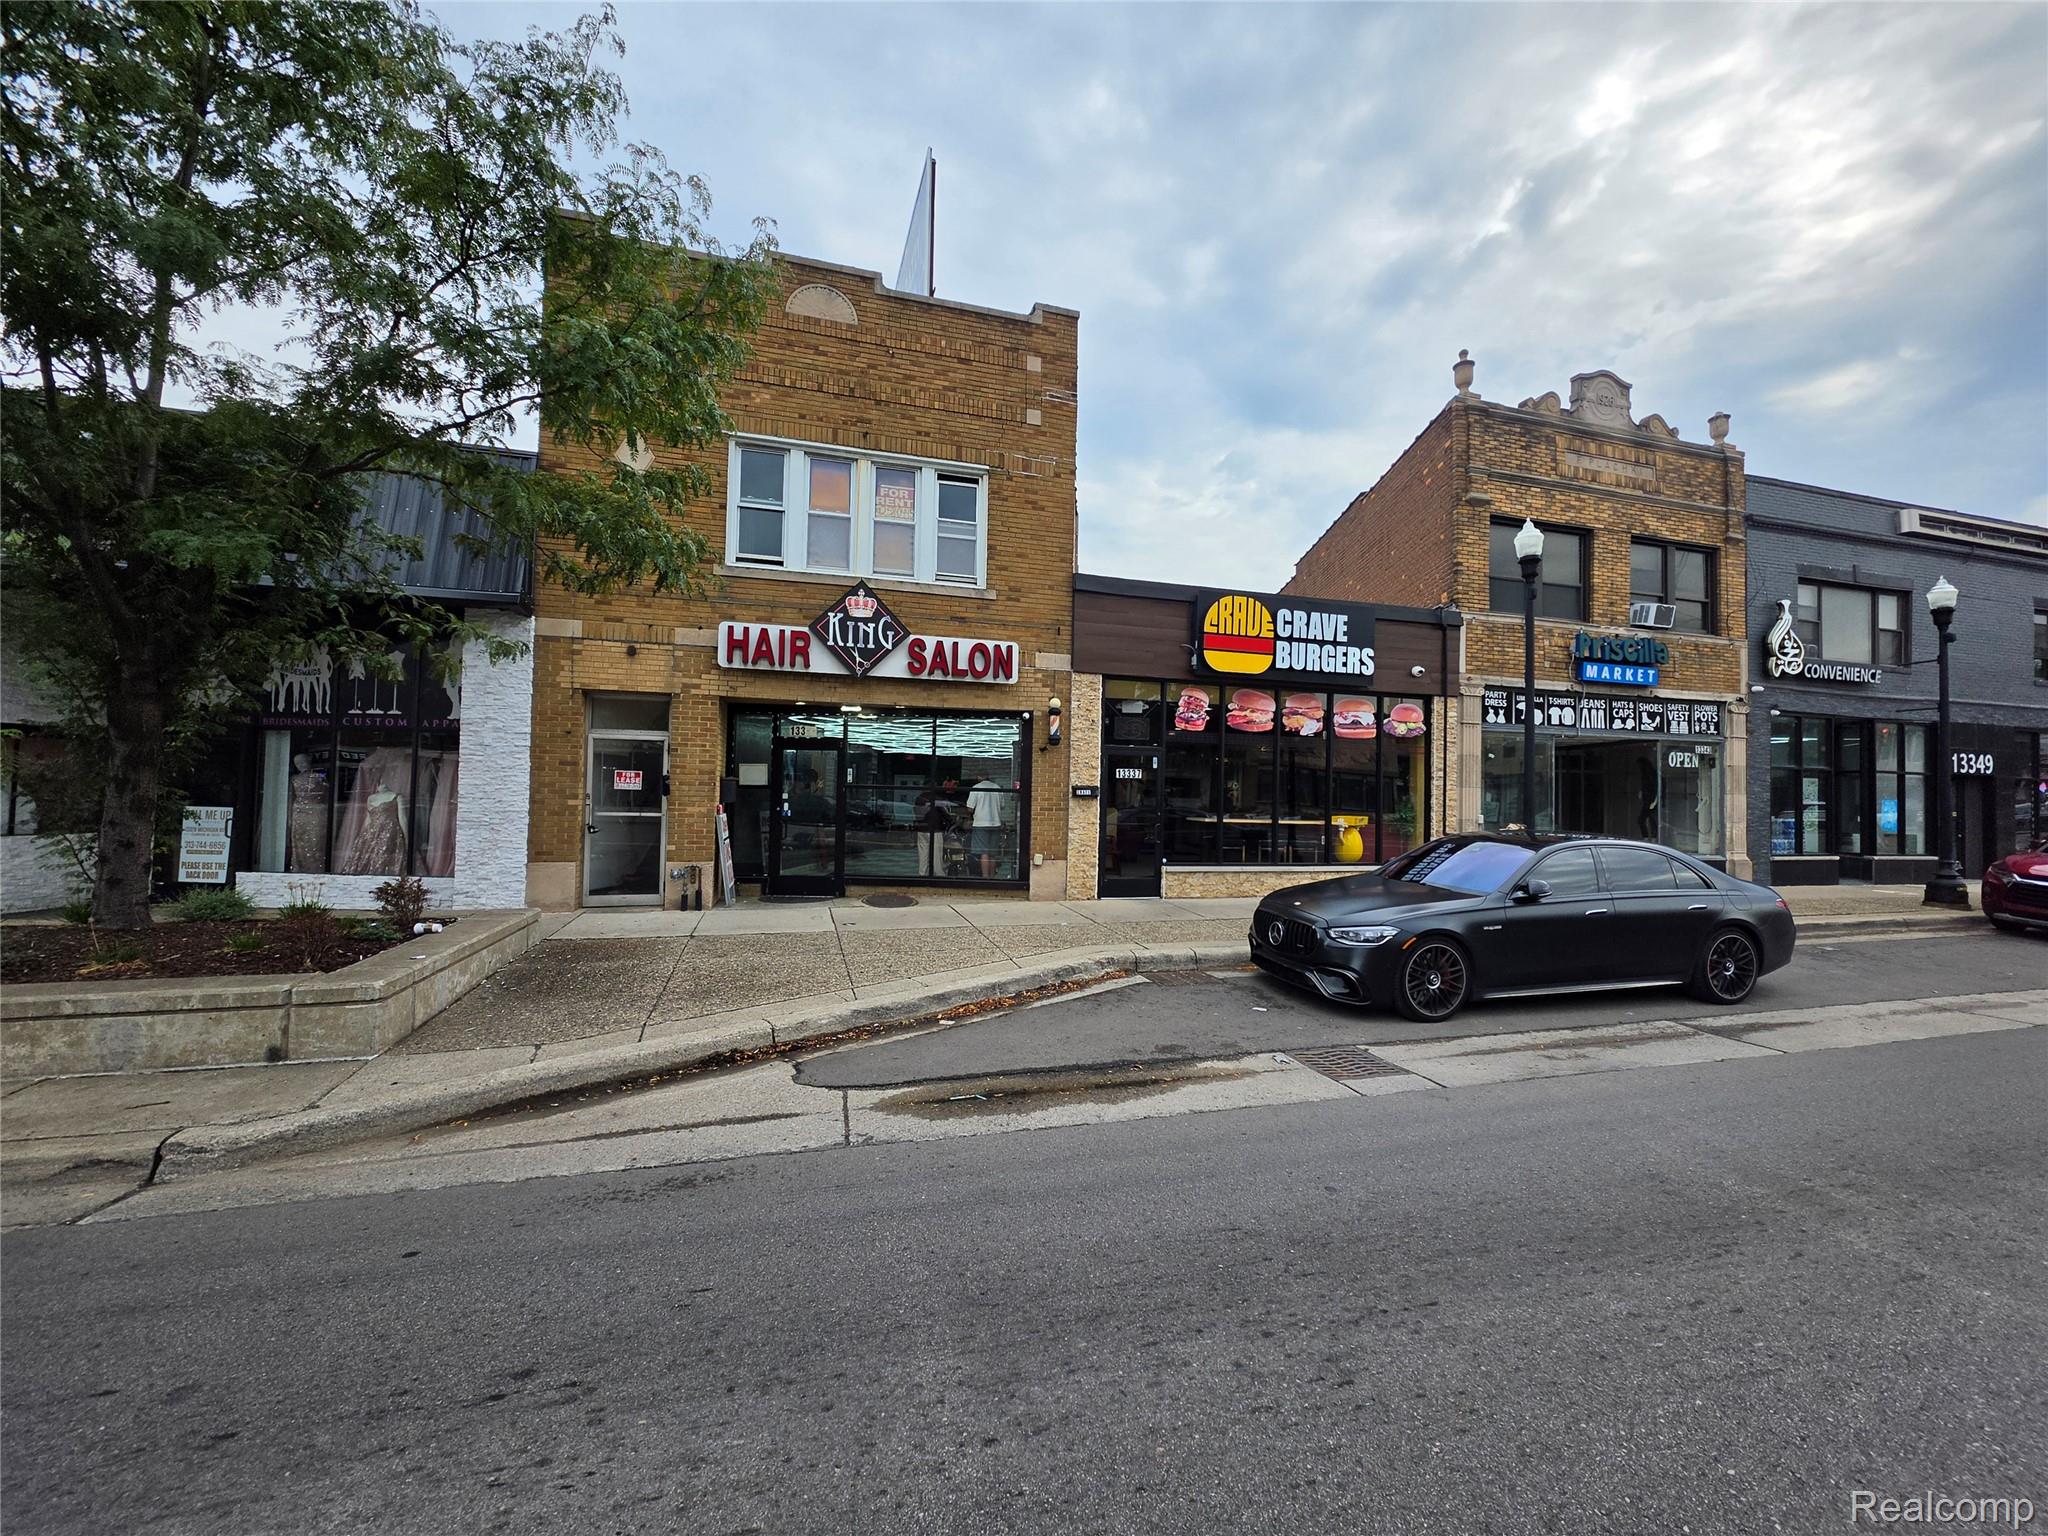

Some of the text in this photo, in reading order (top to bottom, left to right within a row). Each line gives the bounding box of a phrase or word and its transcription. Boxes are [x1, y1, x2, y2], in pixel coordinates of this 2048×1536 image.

[880, 487, 908, 499] FOR
[876, 496, 913, 508] RENT
[1203, 595, 1275, 638] CRAVE
[1276, 608, 1348, 642] CRAVE
[726, 624, 1013, 681] HAIR SALON
[1275, 640, 1375, 676] BURGERS
[1586, 664, 1656, 683] MARKET
[1804, 663, 1882, 684] CONVENIENCE
[1485, 690, 1507, 699] PARTY
[1485, 698, 1507, 707] DRESS
[1548, 697, 1575, 706] T-SHIRTS
[1579, 698, 1606, 708] JEANS
[1612, 701, 1628, 709] HATS
[1667, 703, 1689, 711] SAFETY
[1639, 702, 1663, 713] SHOES
[1694, 704, 1718, 712] FLOWER
[1612, 709, 1635, 718] CAPS
[1667, 711, 1690, 721] VEST
[1694, 711, 1718, 722] POTS
[262, 717, 330, 727] BRIDESMAIDS
[342, 717, 408, 727] CUSTOM
[1668, 751, 1699, 768] OPEN
[1951, 753, 1994, 774] 13349
[1116, 768, 1142, 779] 13337
[205, 810, 217, 820] ME
[220, 810, 231, 820] UP
[181, 861, 200, 870] PLEASE
